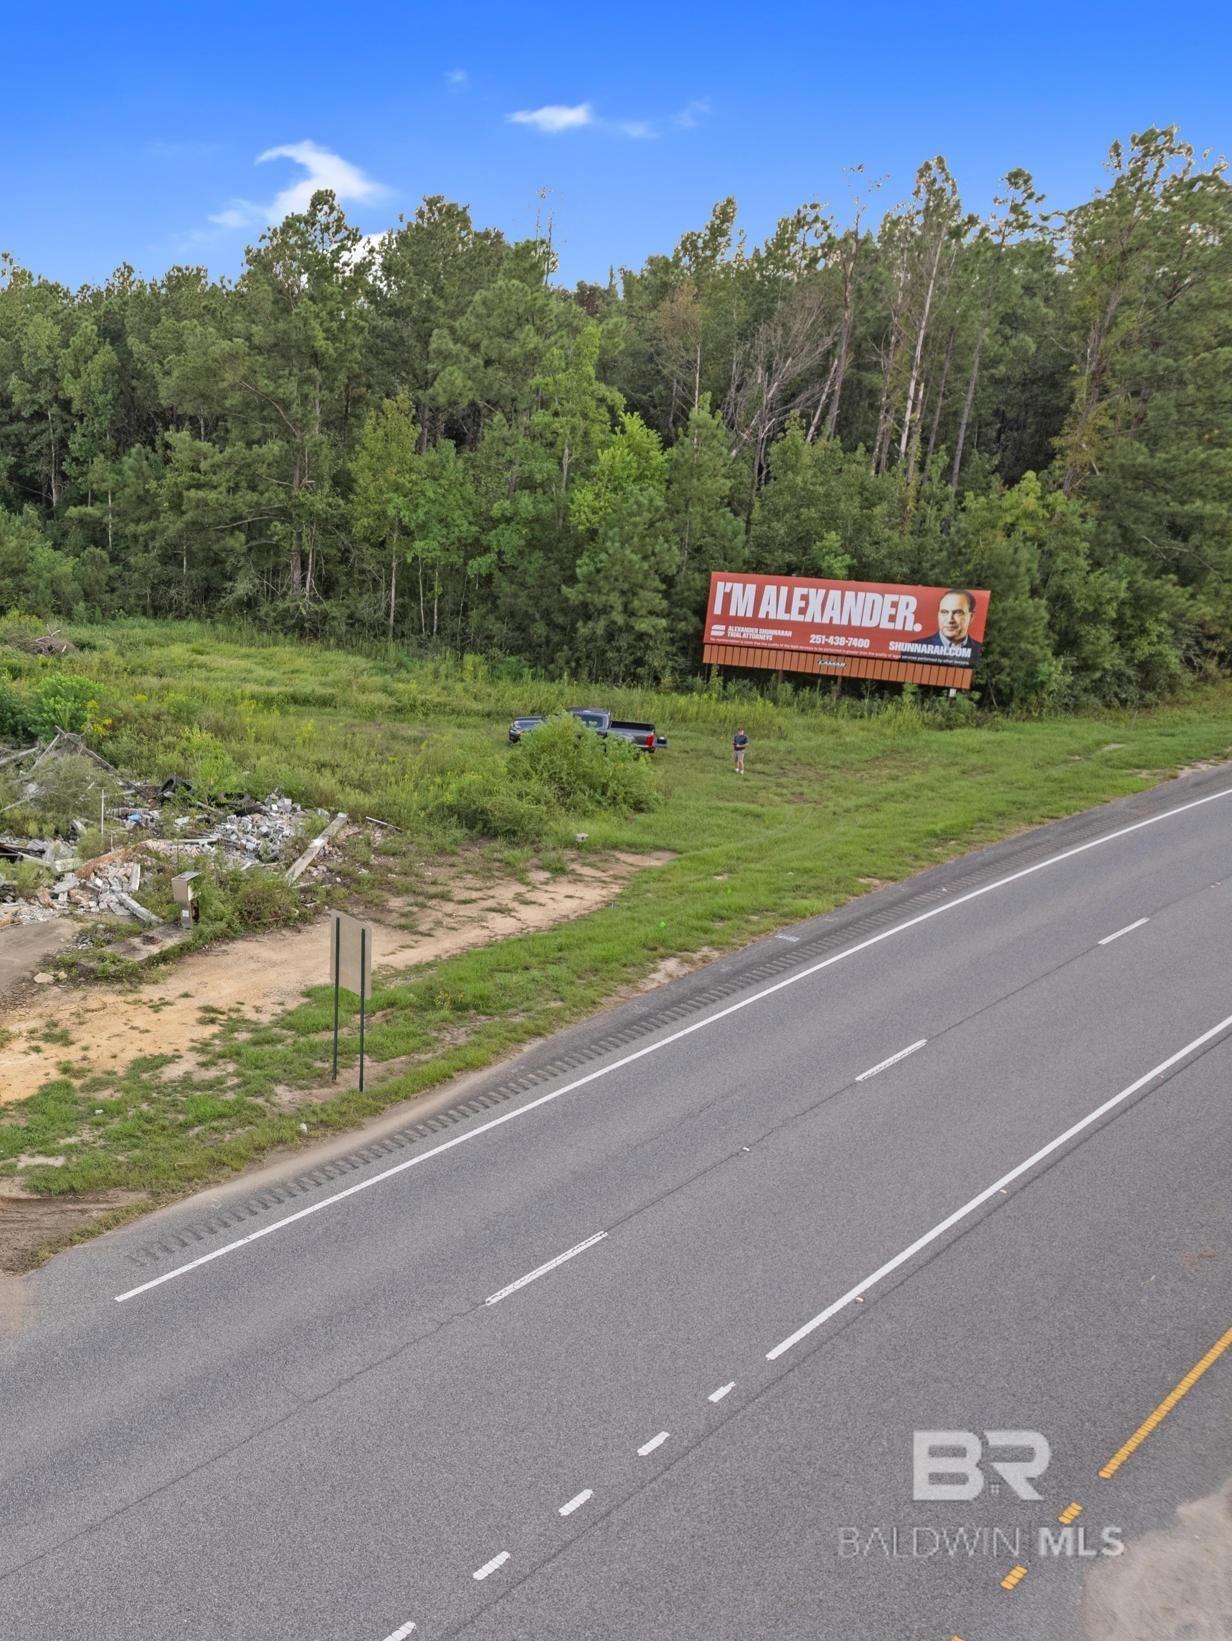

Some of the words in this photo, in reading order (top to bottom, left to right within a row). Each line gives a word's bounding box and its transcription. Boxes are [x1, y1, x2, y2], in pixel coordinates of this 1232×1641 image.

[714, 581, 757, 617] I'M
[758, 585, 923, 632] ALEXANDER.
[809, 634, 870, 649] 251-438-7400
[888, 641, 971, 658] SHUNNARAH.COM
